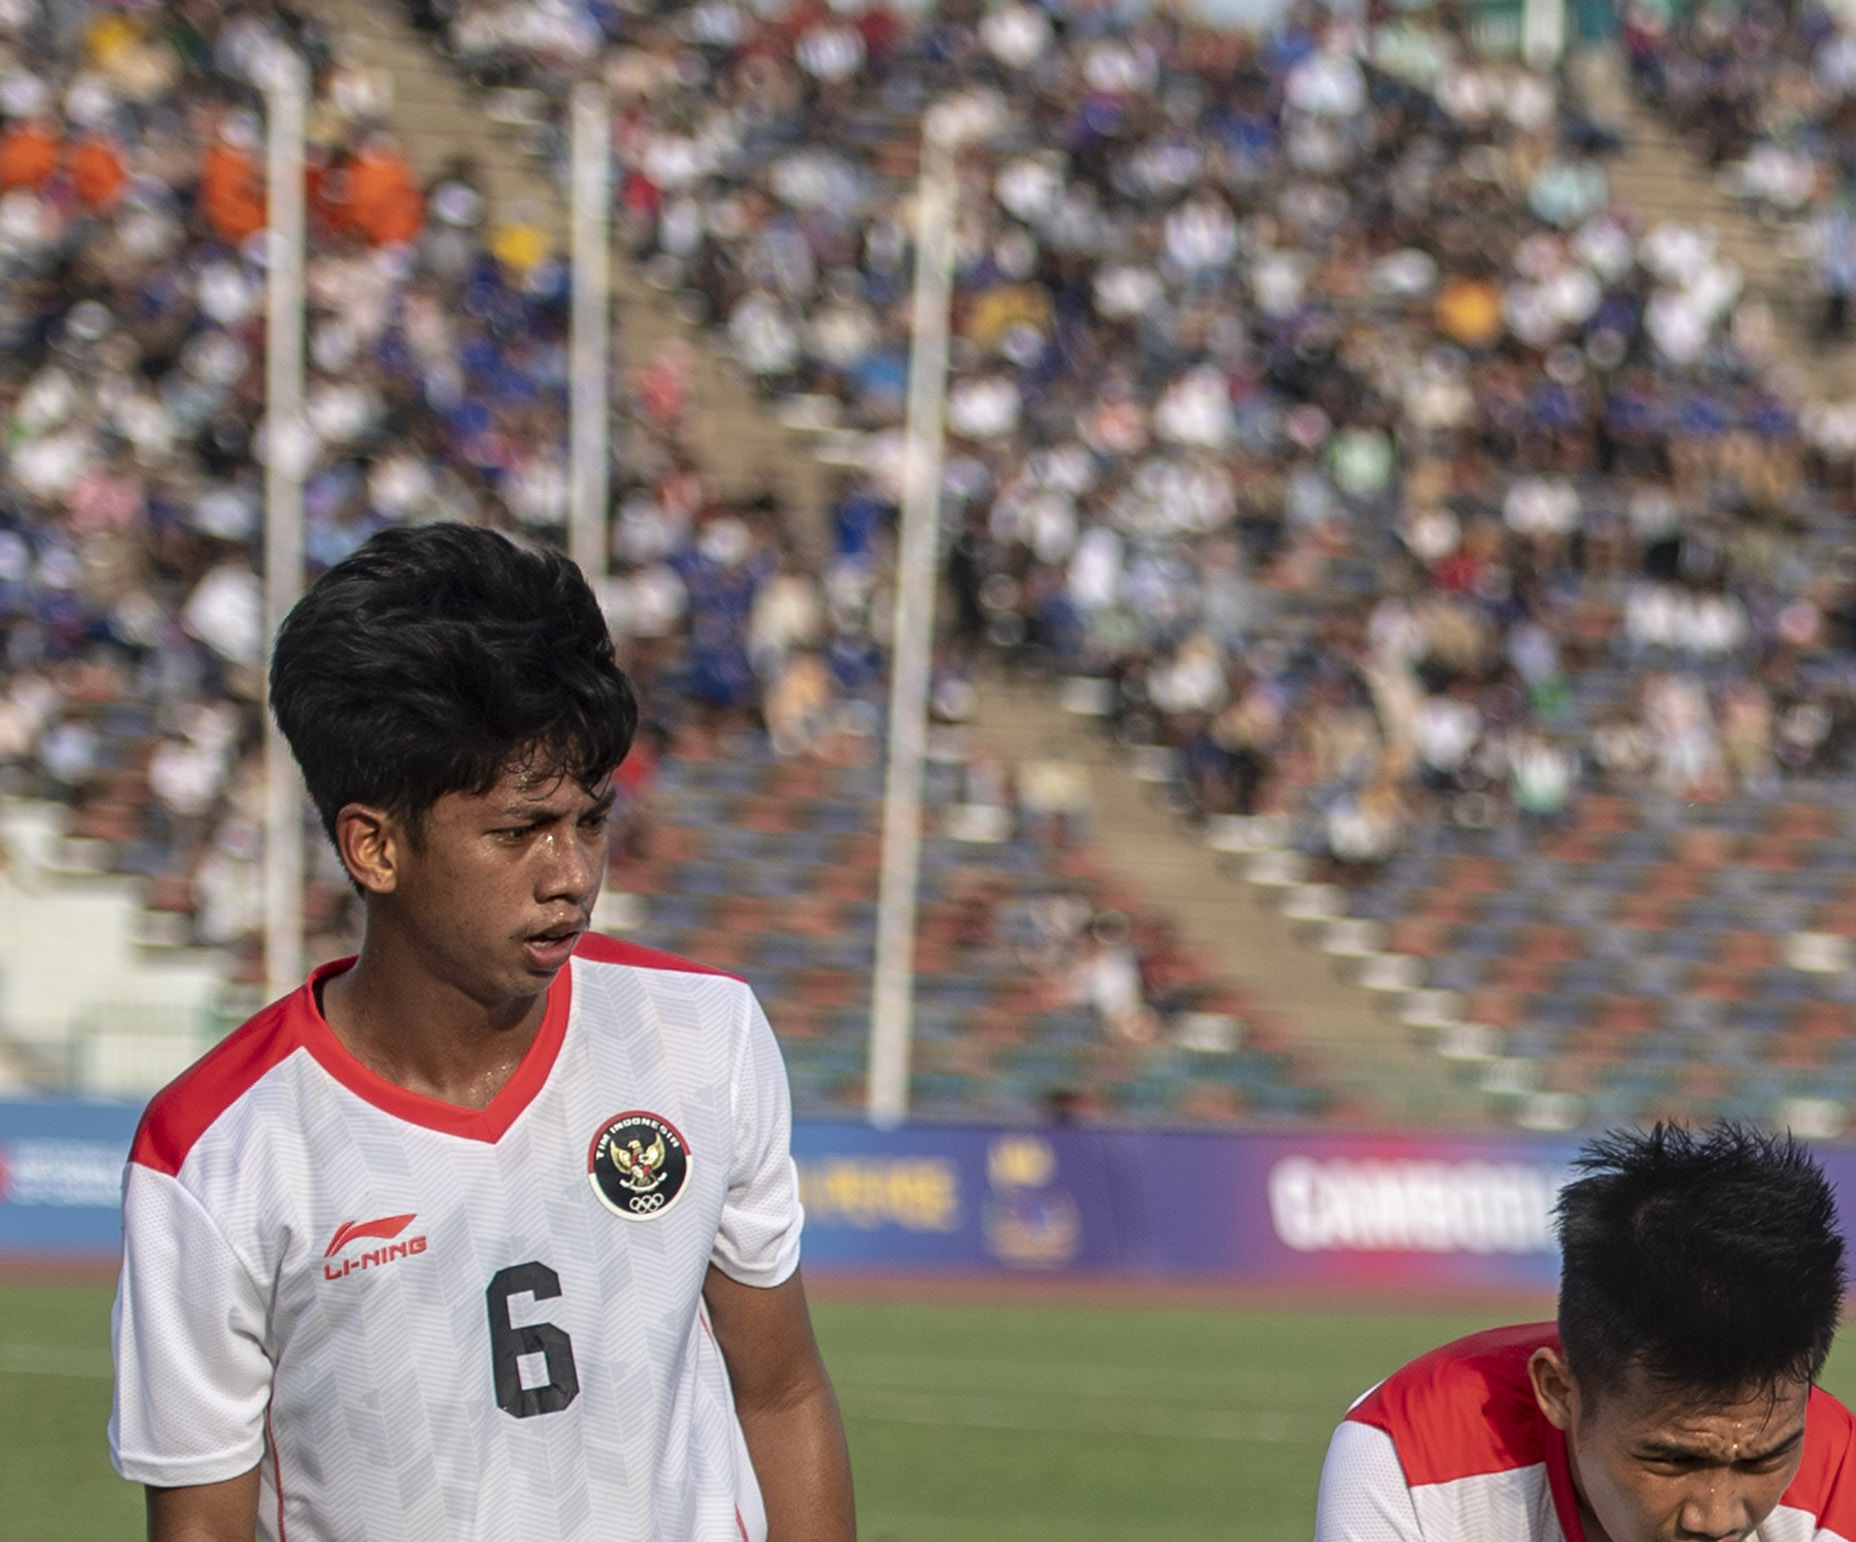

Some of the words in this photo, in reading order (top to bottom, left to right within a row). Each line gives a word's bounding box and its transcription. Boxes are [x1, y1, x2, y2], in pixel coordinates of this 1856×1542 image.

[595, 1133, 611, 1161] TIM
[609, 1117, 681, 1148] INDONESIA
[323, 1234, 428, 1281] LI-NING
[485, 1260, 580, 1420] 6
